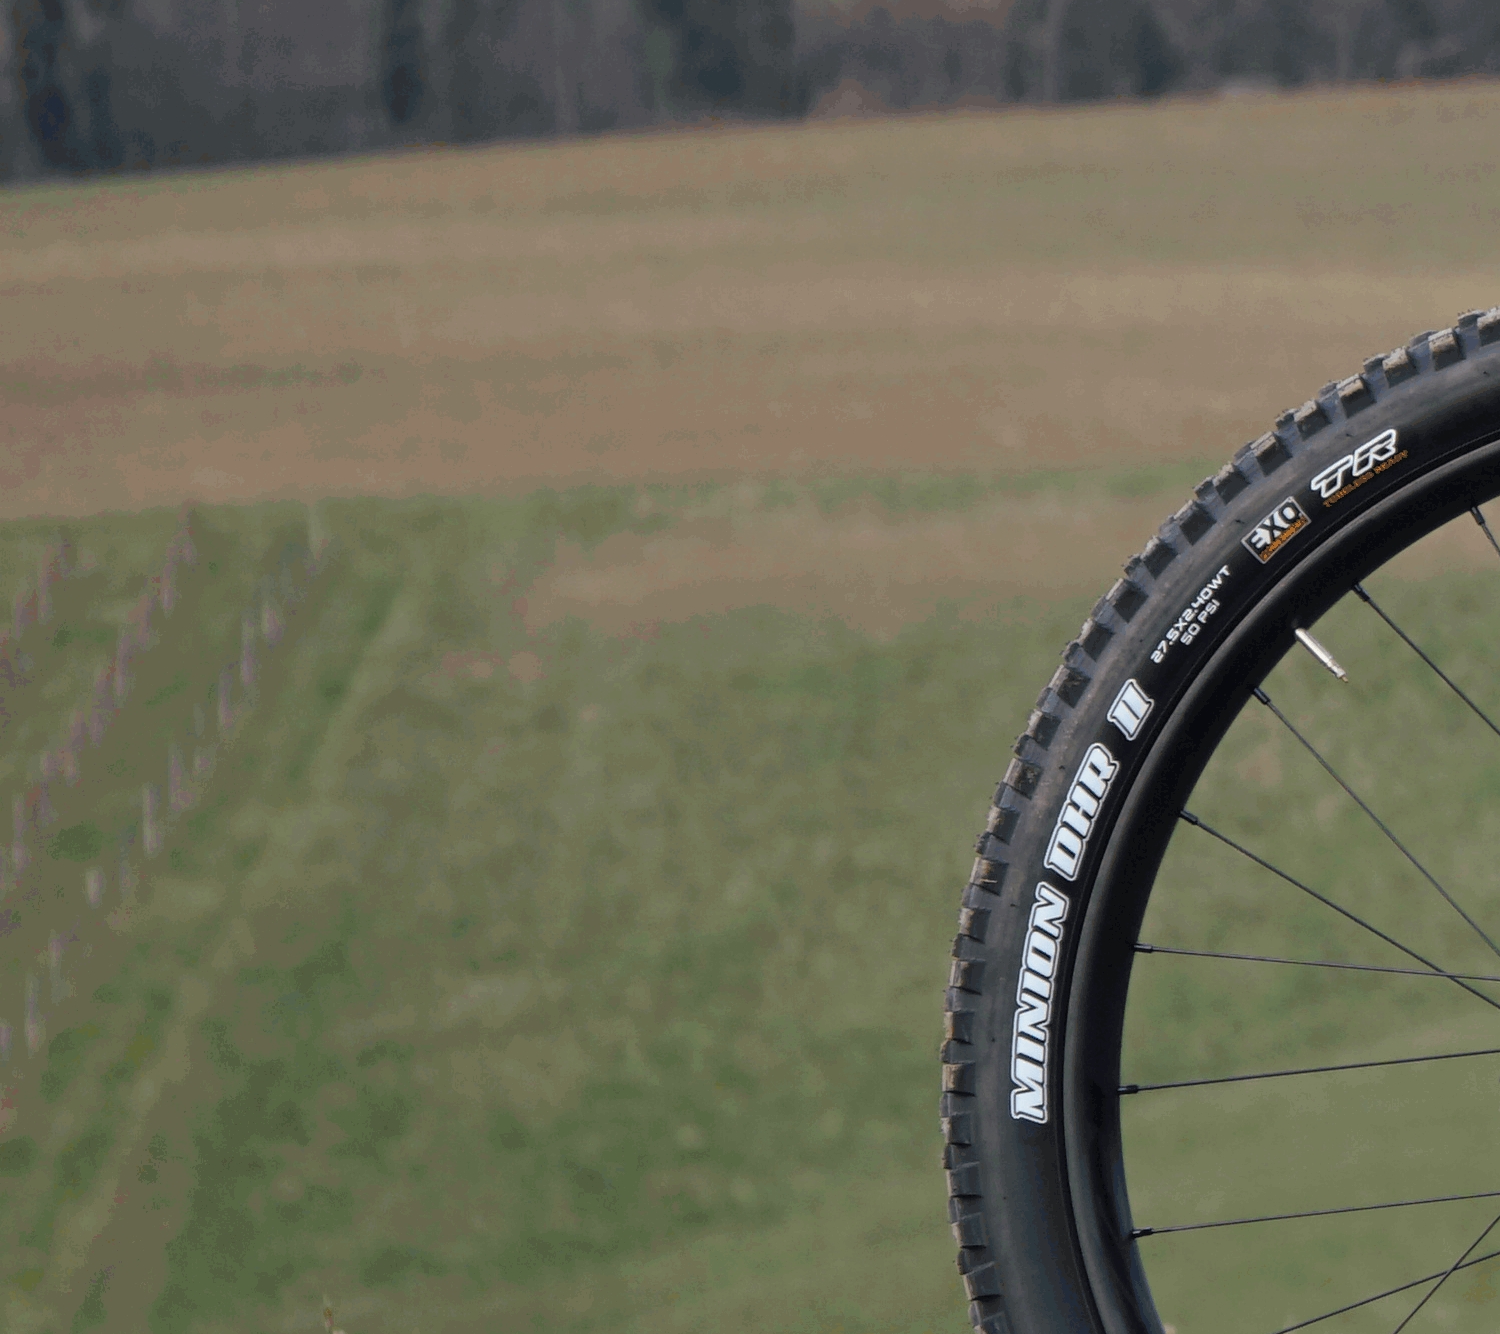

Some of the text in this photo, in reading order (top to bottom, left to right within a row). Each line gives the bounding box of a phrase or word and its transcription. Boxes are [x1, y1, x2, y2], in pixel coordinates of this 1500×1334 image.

[1311, 428, 1397, 498] TR
[1247, 504, 1302, 551] EXO
[1180, 599, 1221, 646] 50 PSI
[1010, 881, 1070, 1125] MINION
[1044, 741, 1120, 881] DHR
